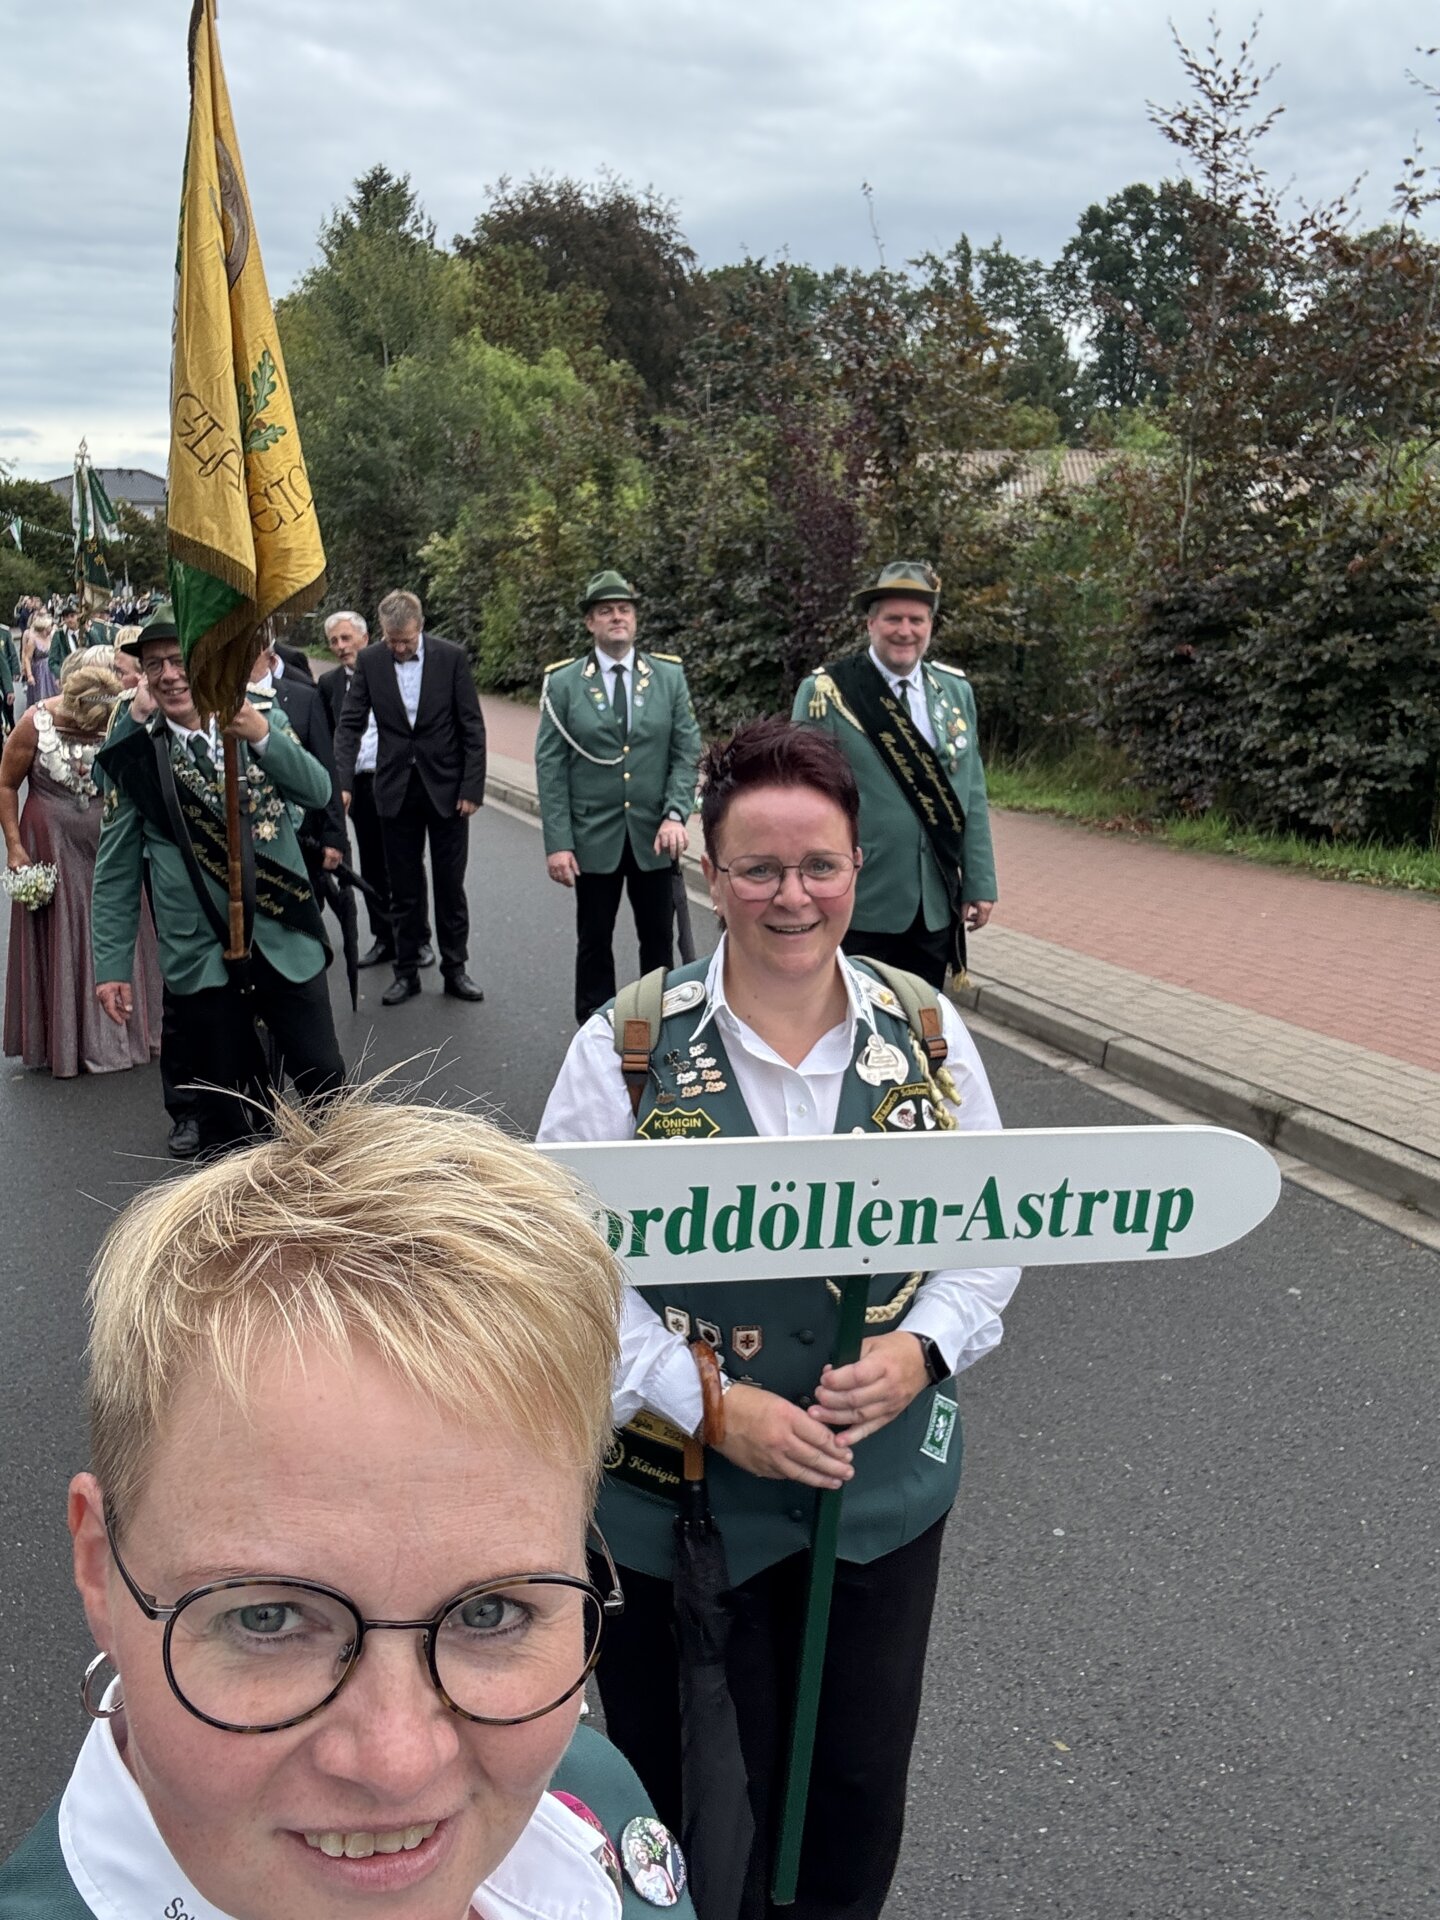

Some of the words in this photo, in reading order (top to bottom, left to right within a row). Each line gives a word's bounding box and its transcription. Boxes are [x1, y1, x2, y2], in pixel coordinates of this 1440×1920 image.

[654, 1116, 702, 1130] KÖNIGIN
[665, 1128, 687, 1136] 2025
[592, 1175, 1195, 1258] orddöllen-Astrup
[628, 1455, 681, 1484] Königin
